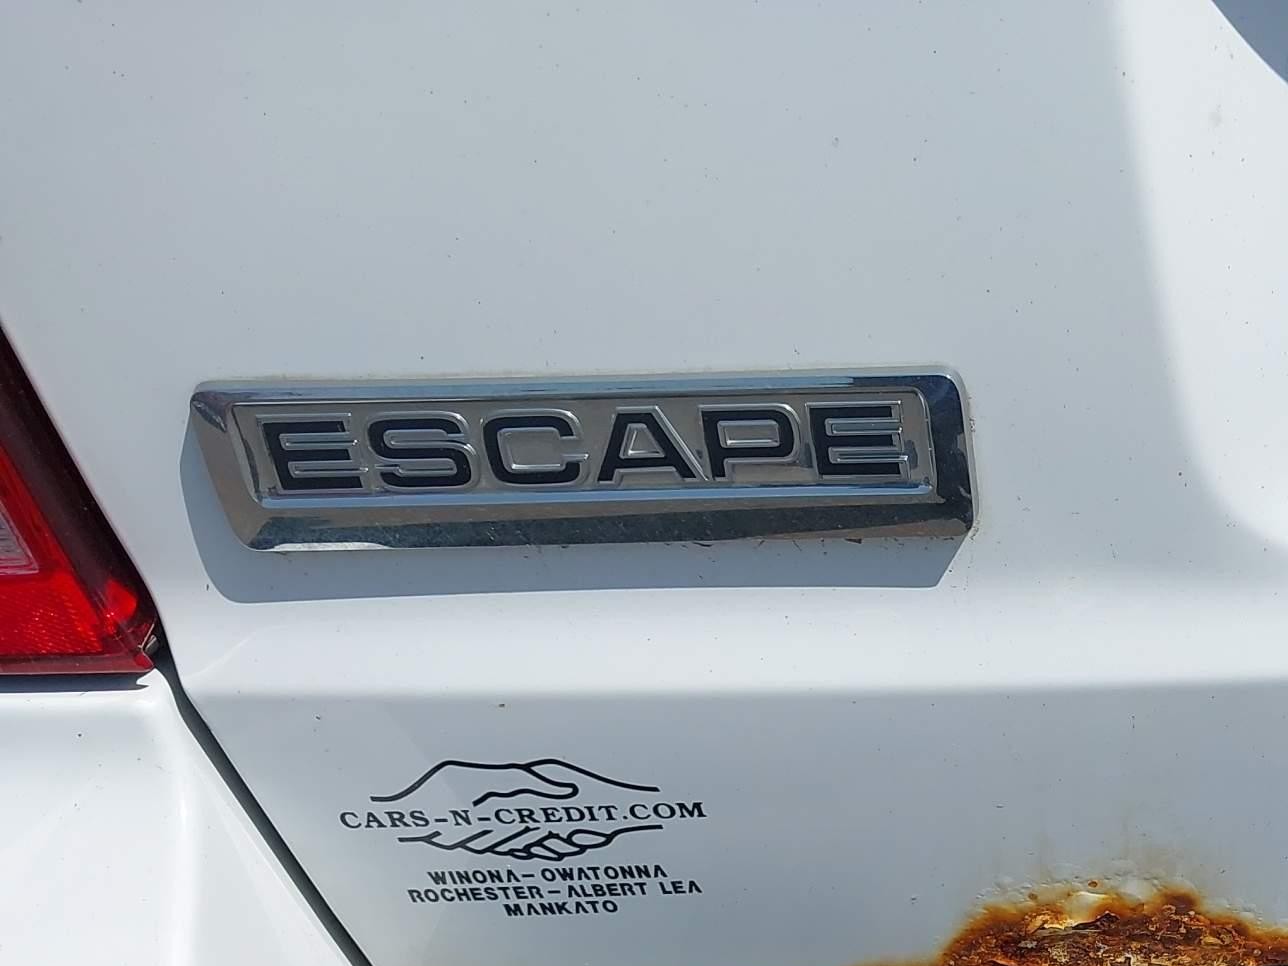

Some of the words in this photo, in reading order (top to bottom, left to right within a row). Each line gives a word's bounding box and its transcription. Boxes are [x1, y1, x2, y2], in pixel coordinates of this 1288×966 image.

[257, 400, 910, 493] ESCAPE
[339, 801, 708, 830] CARS-N-CREDIT.COM
[658, 880, 703, 895] LEA
[502, 900, 619, 917] MANKATO
